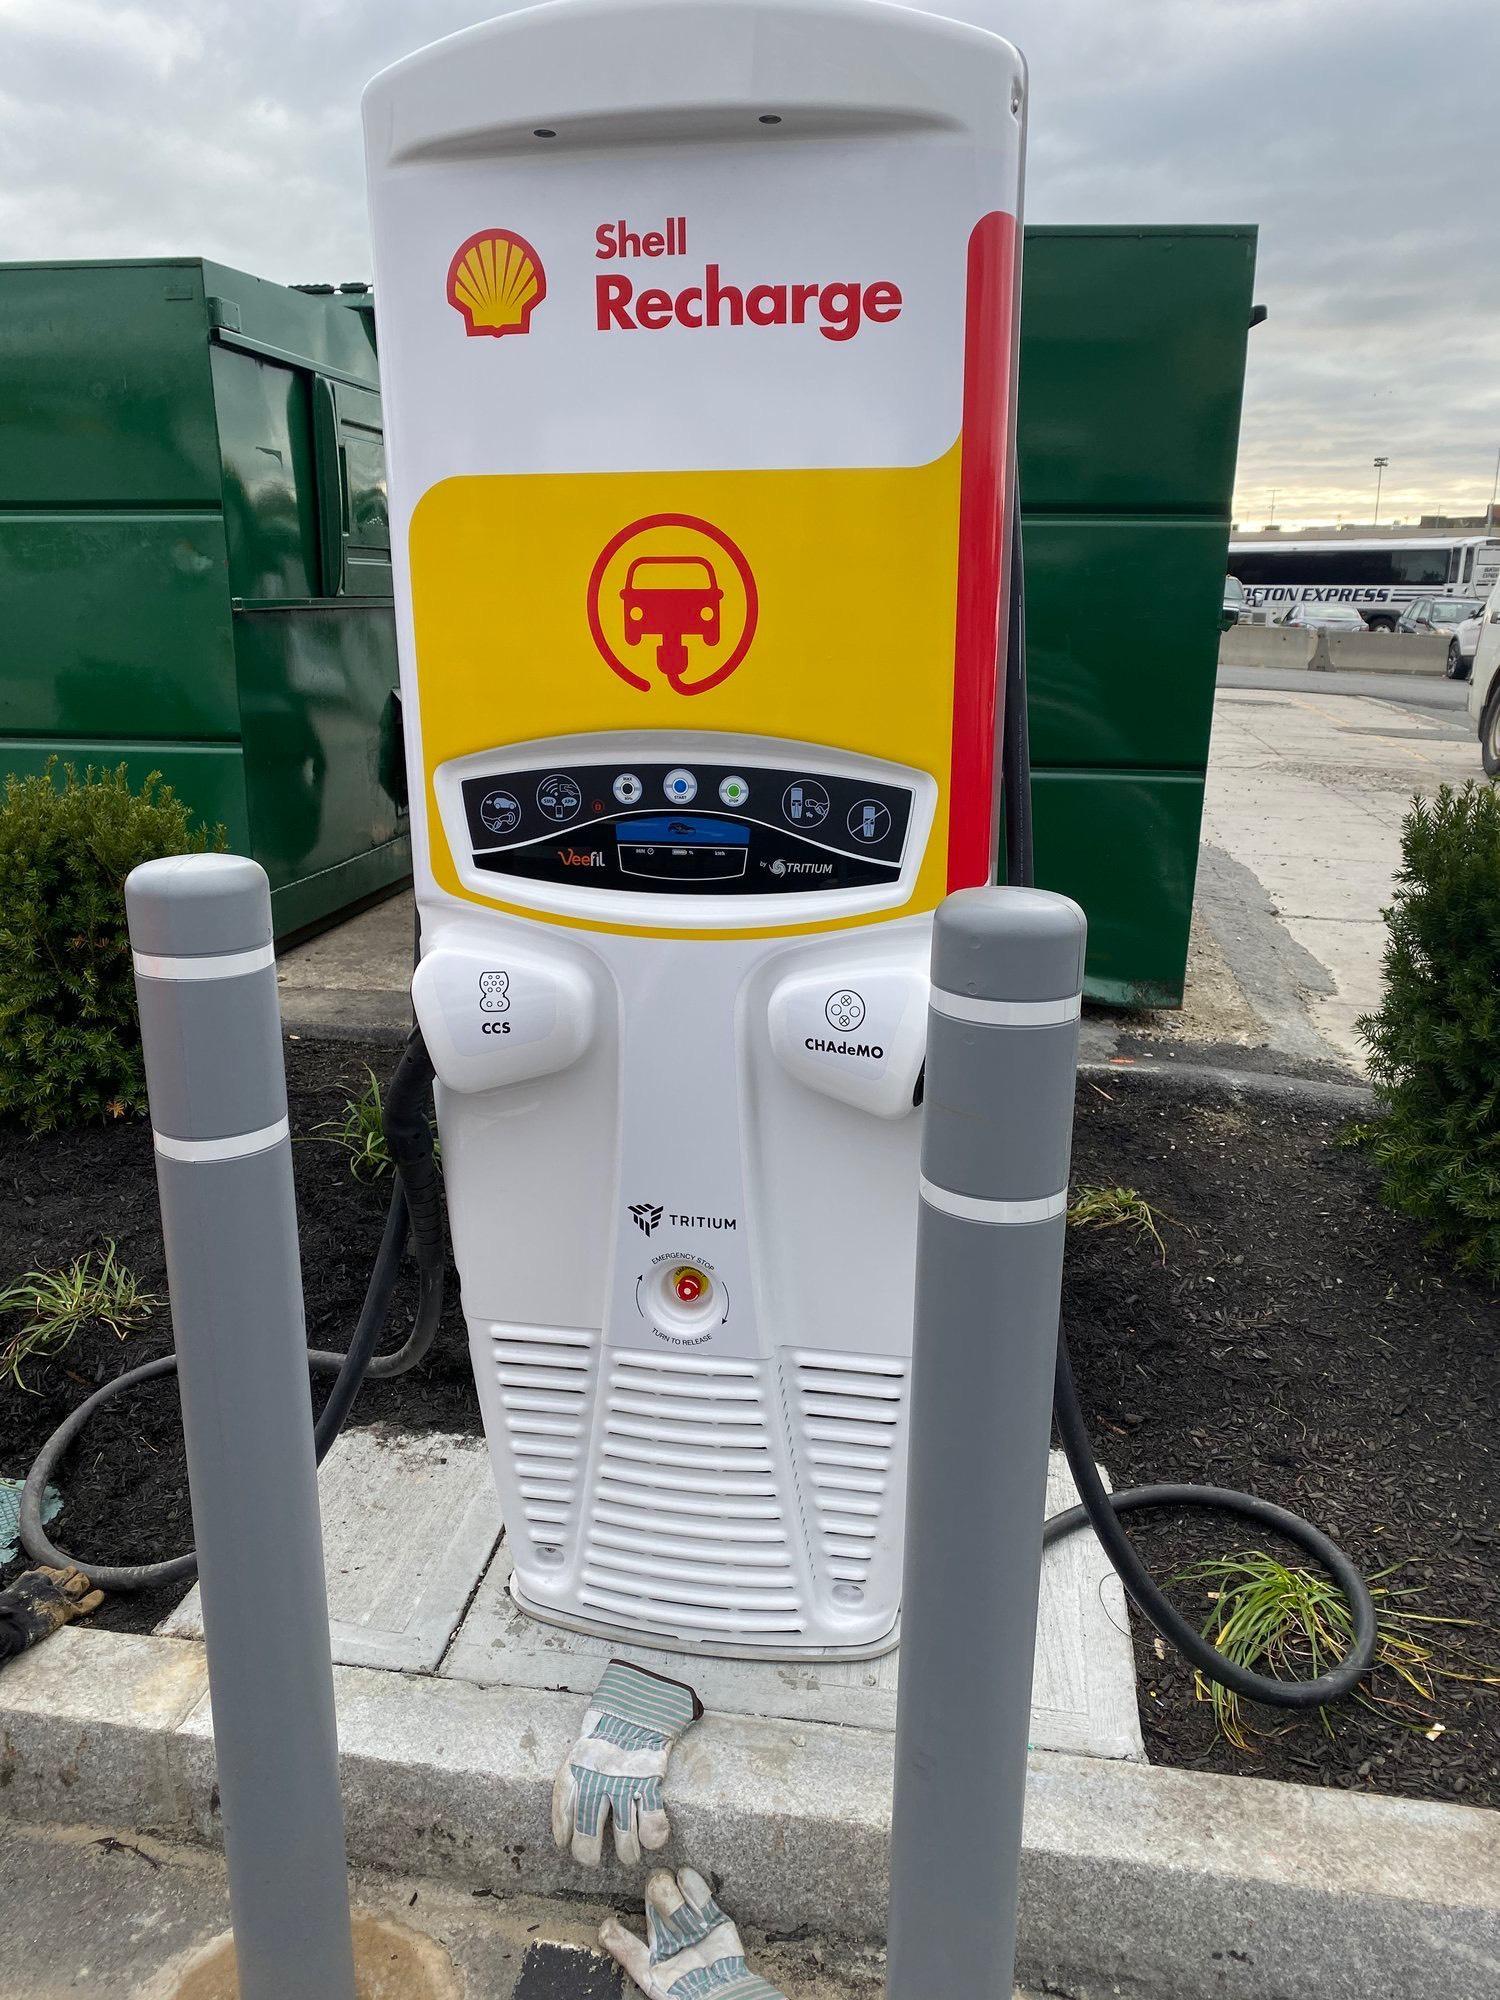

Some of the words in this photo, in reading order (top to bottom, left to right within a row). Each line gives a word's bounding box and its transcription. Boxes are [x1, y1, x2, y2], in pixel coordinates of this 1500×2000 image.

[595, 216, 687, 260] Shell
[595, 264, 902, 341] Recharge
[1301, 588, 1390, 602] EXPRESS
[557, 848, 606, 866] Veefil
[759, 860, 767, 868] by
[786, 862, 833, 874] TRITIUM
[481, 1021, 511, 1035] CCS
[804, 1037, 884, 1060] CHAdeMO
[669, 1214, 737, 1231] TRITIUM
[651, 1252, 696, 1265] EMERGENCY
[696, 1257, 715, 1271] STOP
[651, 1327, 671, 1342] TURN
[671, 1337, 681, 1345] TO
[682, 1333, 713, 1347] RELEASE
